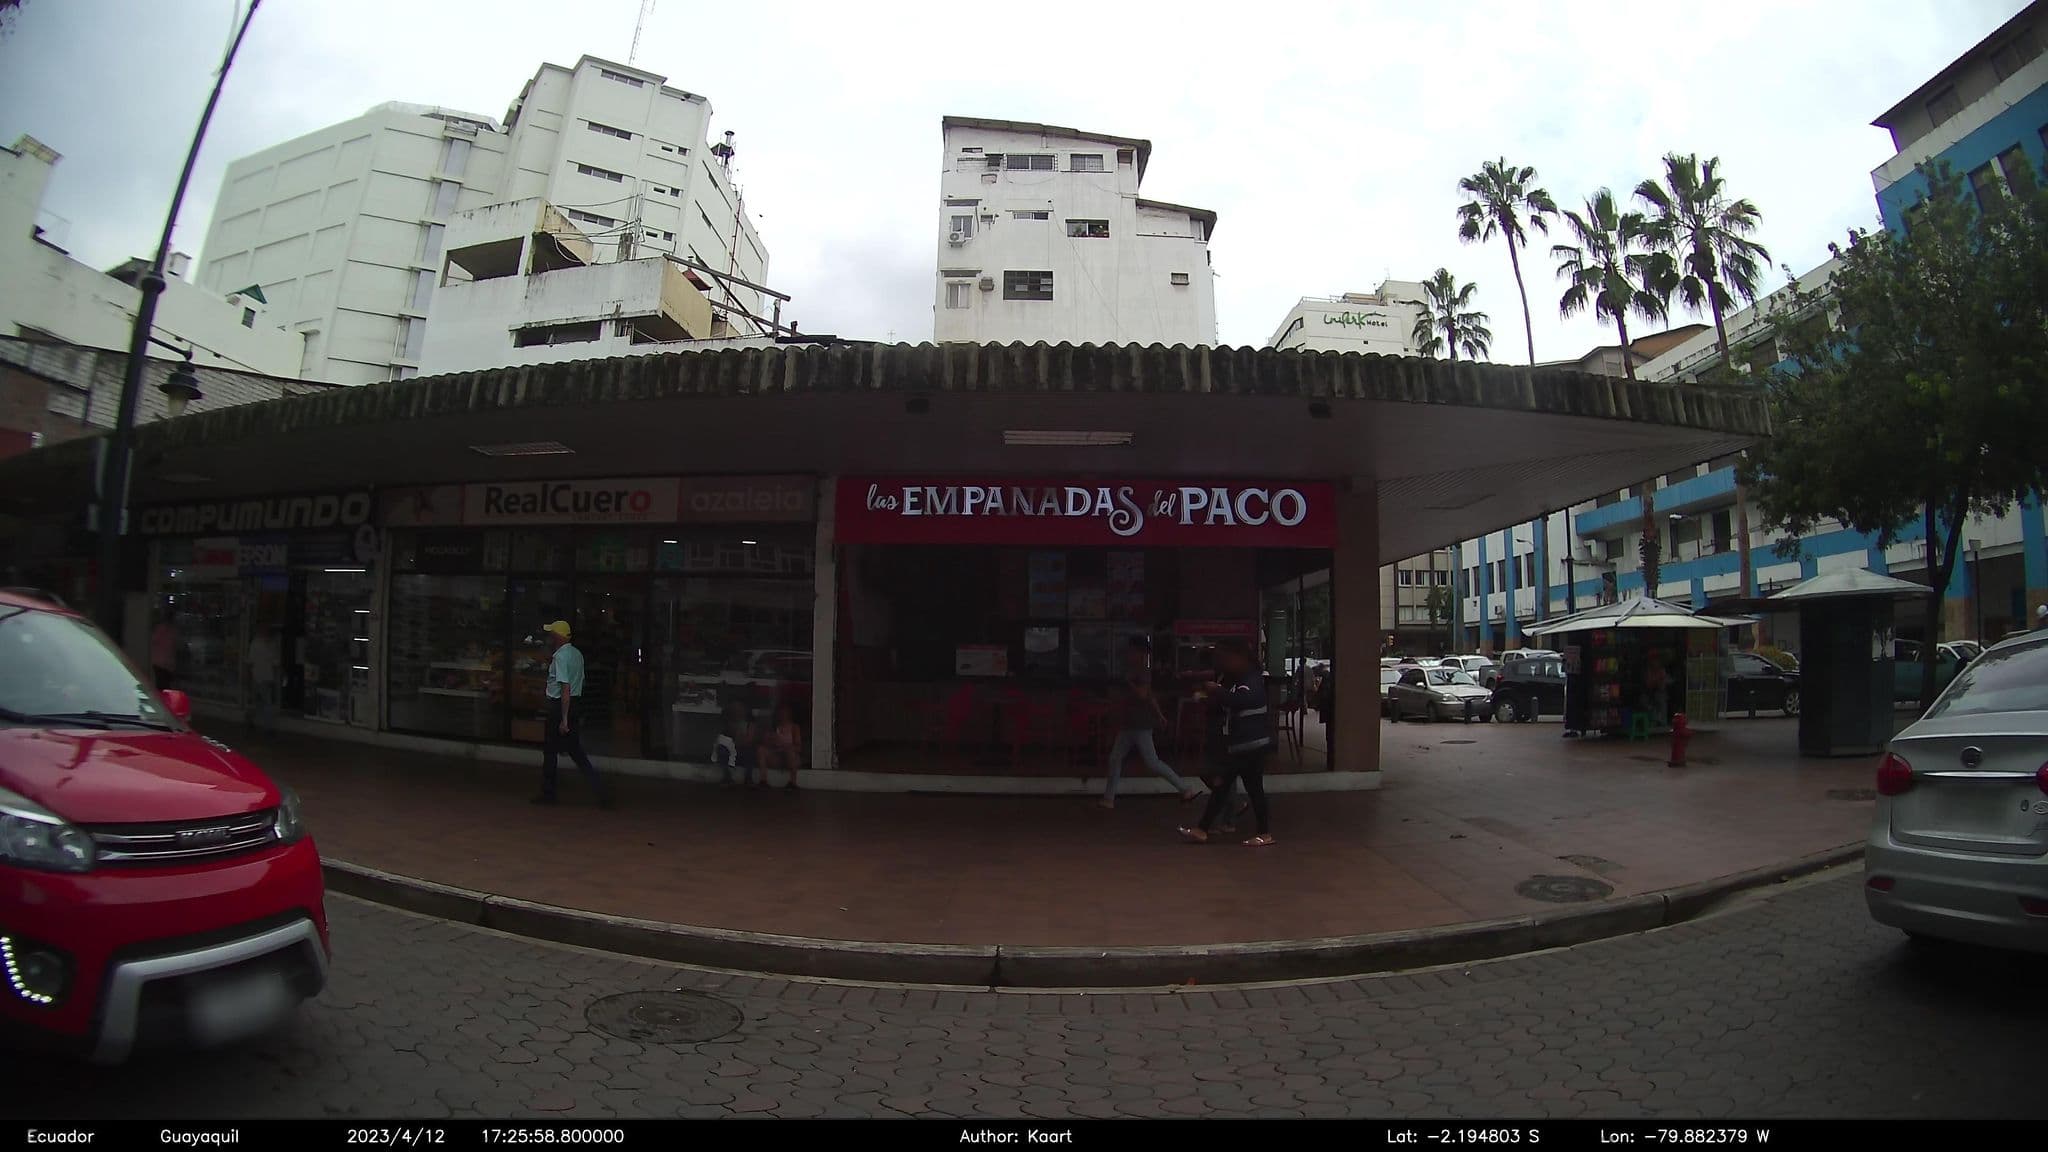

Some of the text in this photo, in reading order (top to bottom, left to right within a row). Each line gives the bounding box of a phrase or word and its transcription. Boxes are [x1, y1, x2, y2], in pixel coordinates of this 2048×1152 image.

[485, 483, 651, 515] RealCuero
[691, 486, 804, 513] azaleia
[866, 484, 1308, 536] las EMPANADAS del PACO
